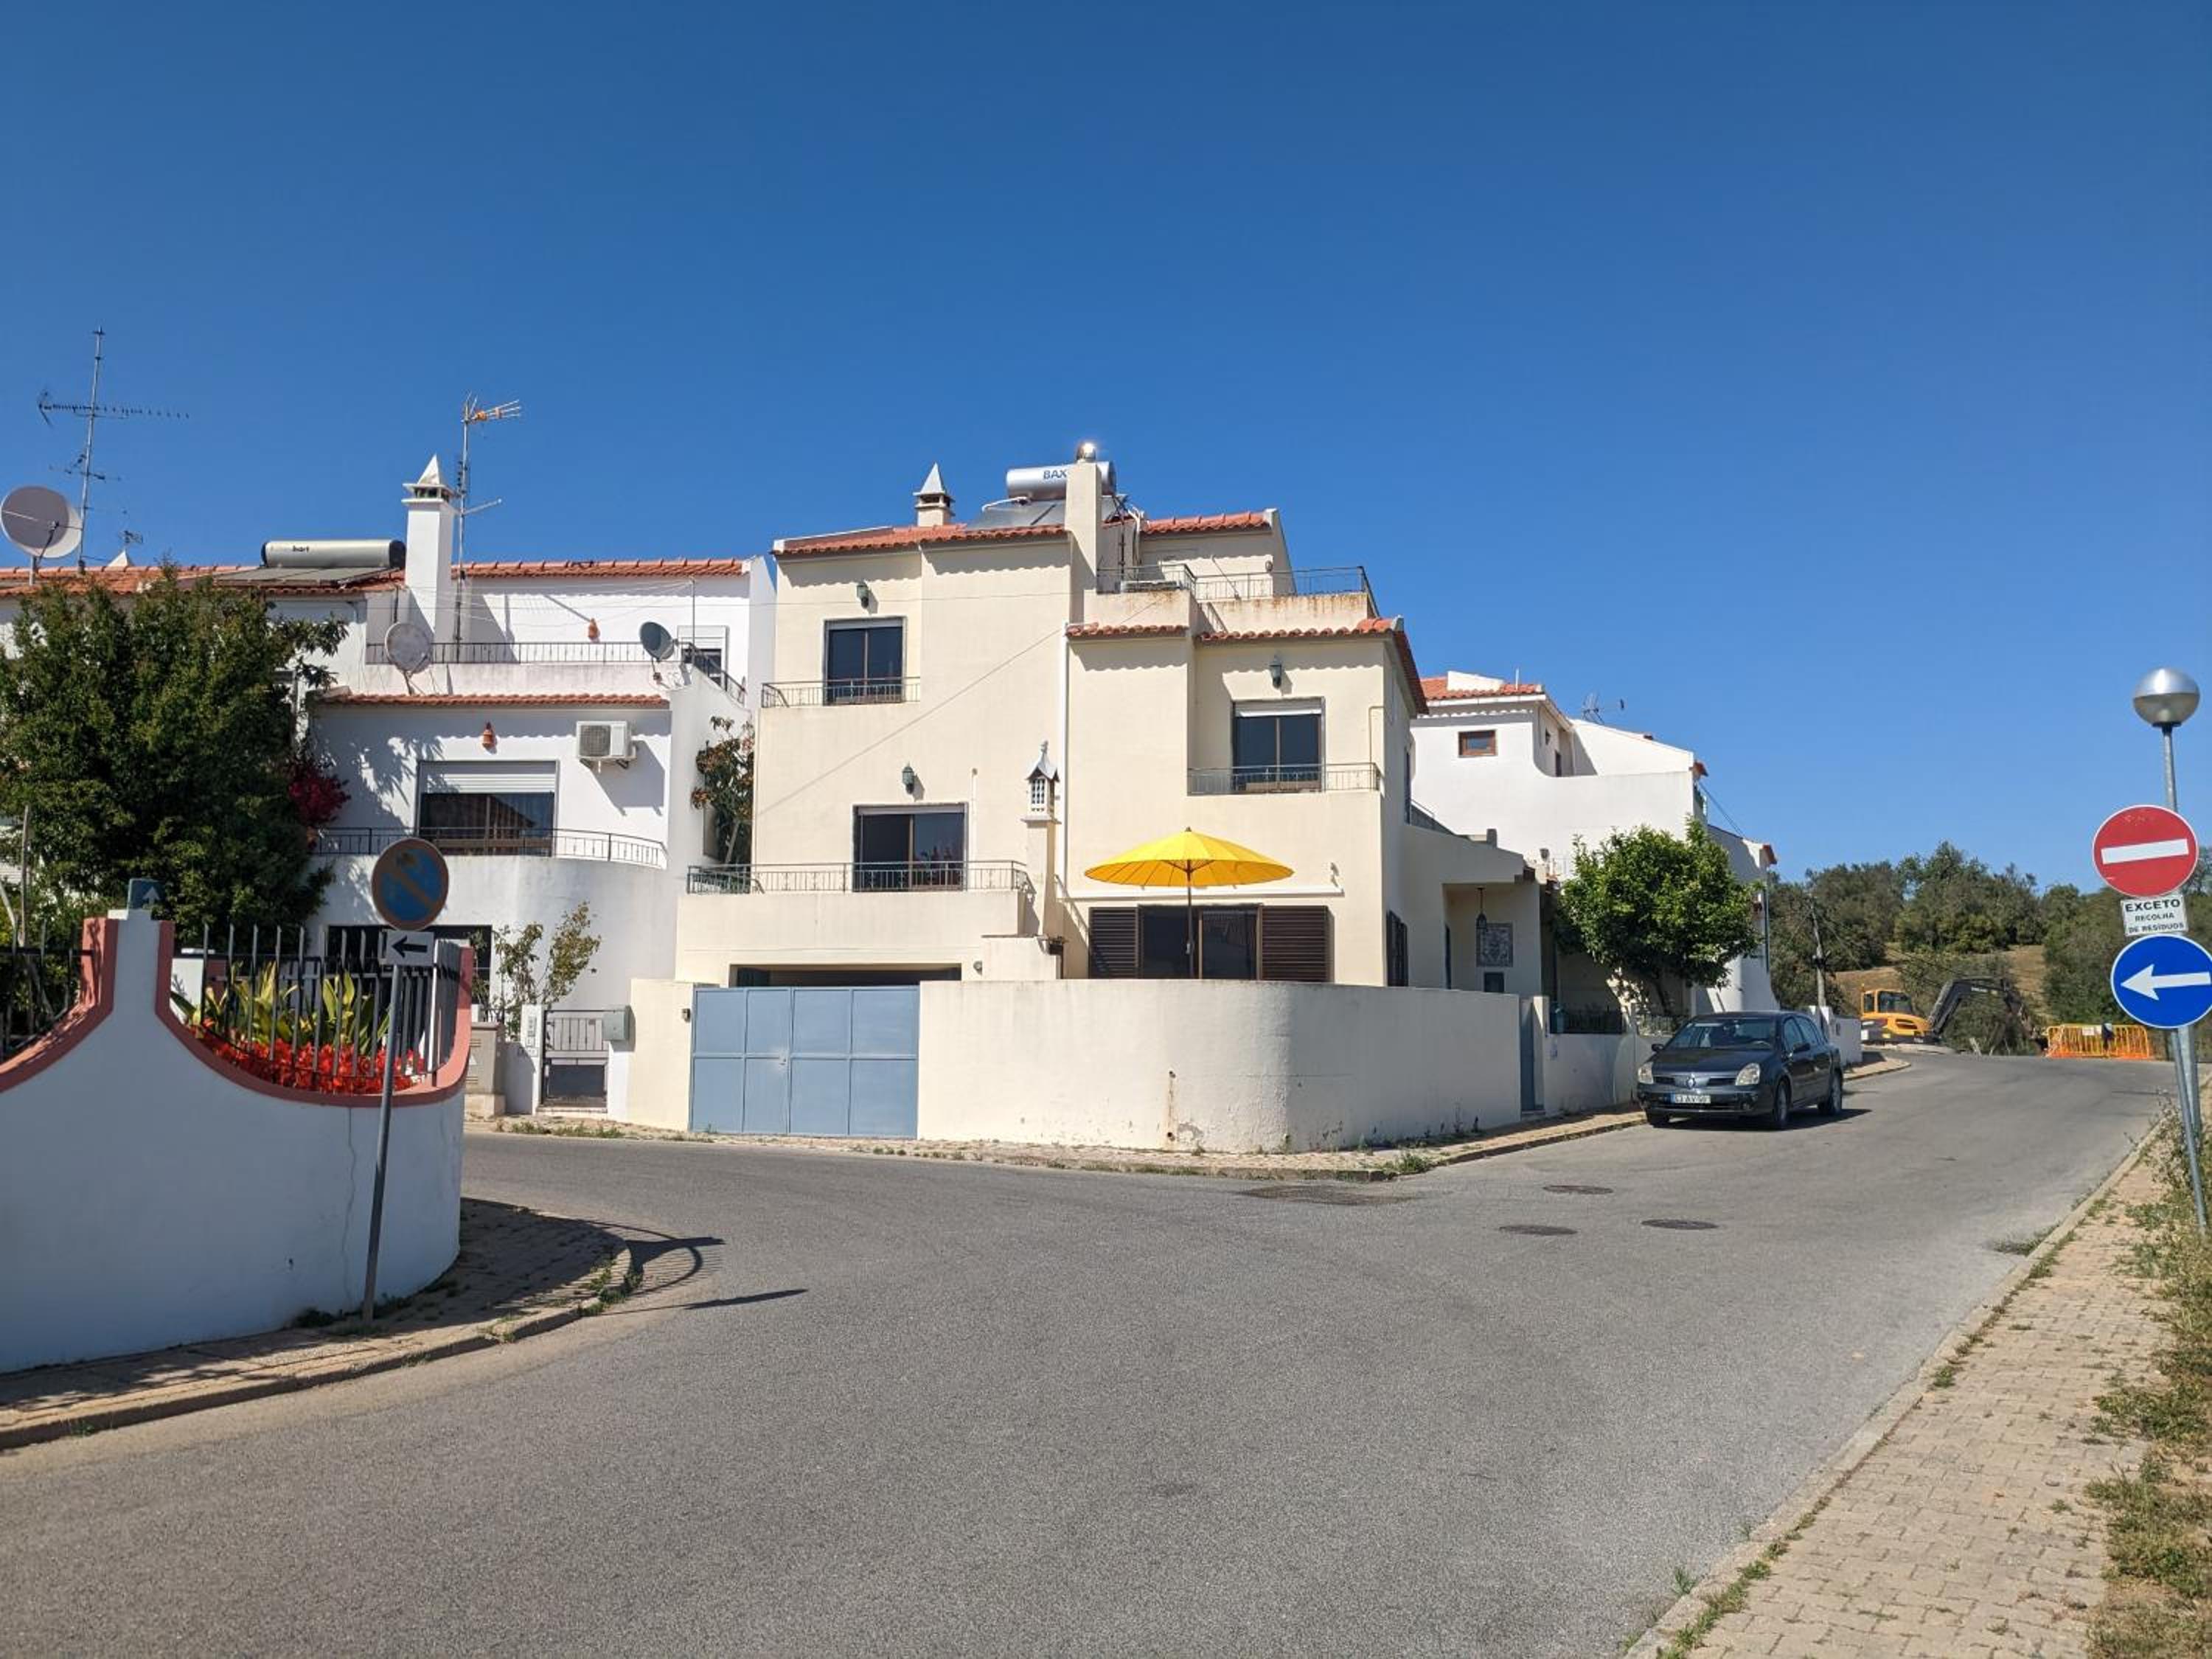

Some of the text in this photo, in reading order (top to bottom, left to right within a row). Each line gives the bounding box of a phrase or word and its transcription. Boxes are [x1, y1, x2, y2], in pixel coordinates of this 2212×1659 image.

[1043, 469, 1067, 479] BAX
[2125, 899, 2180, 912] EXCETO
[2135, 913, 2174, 922] RECOLHA
